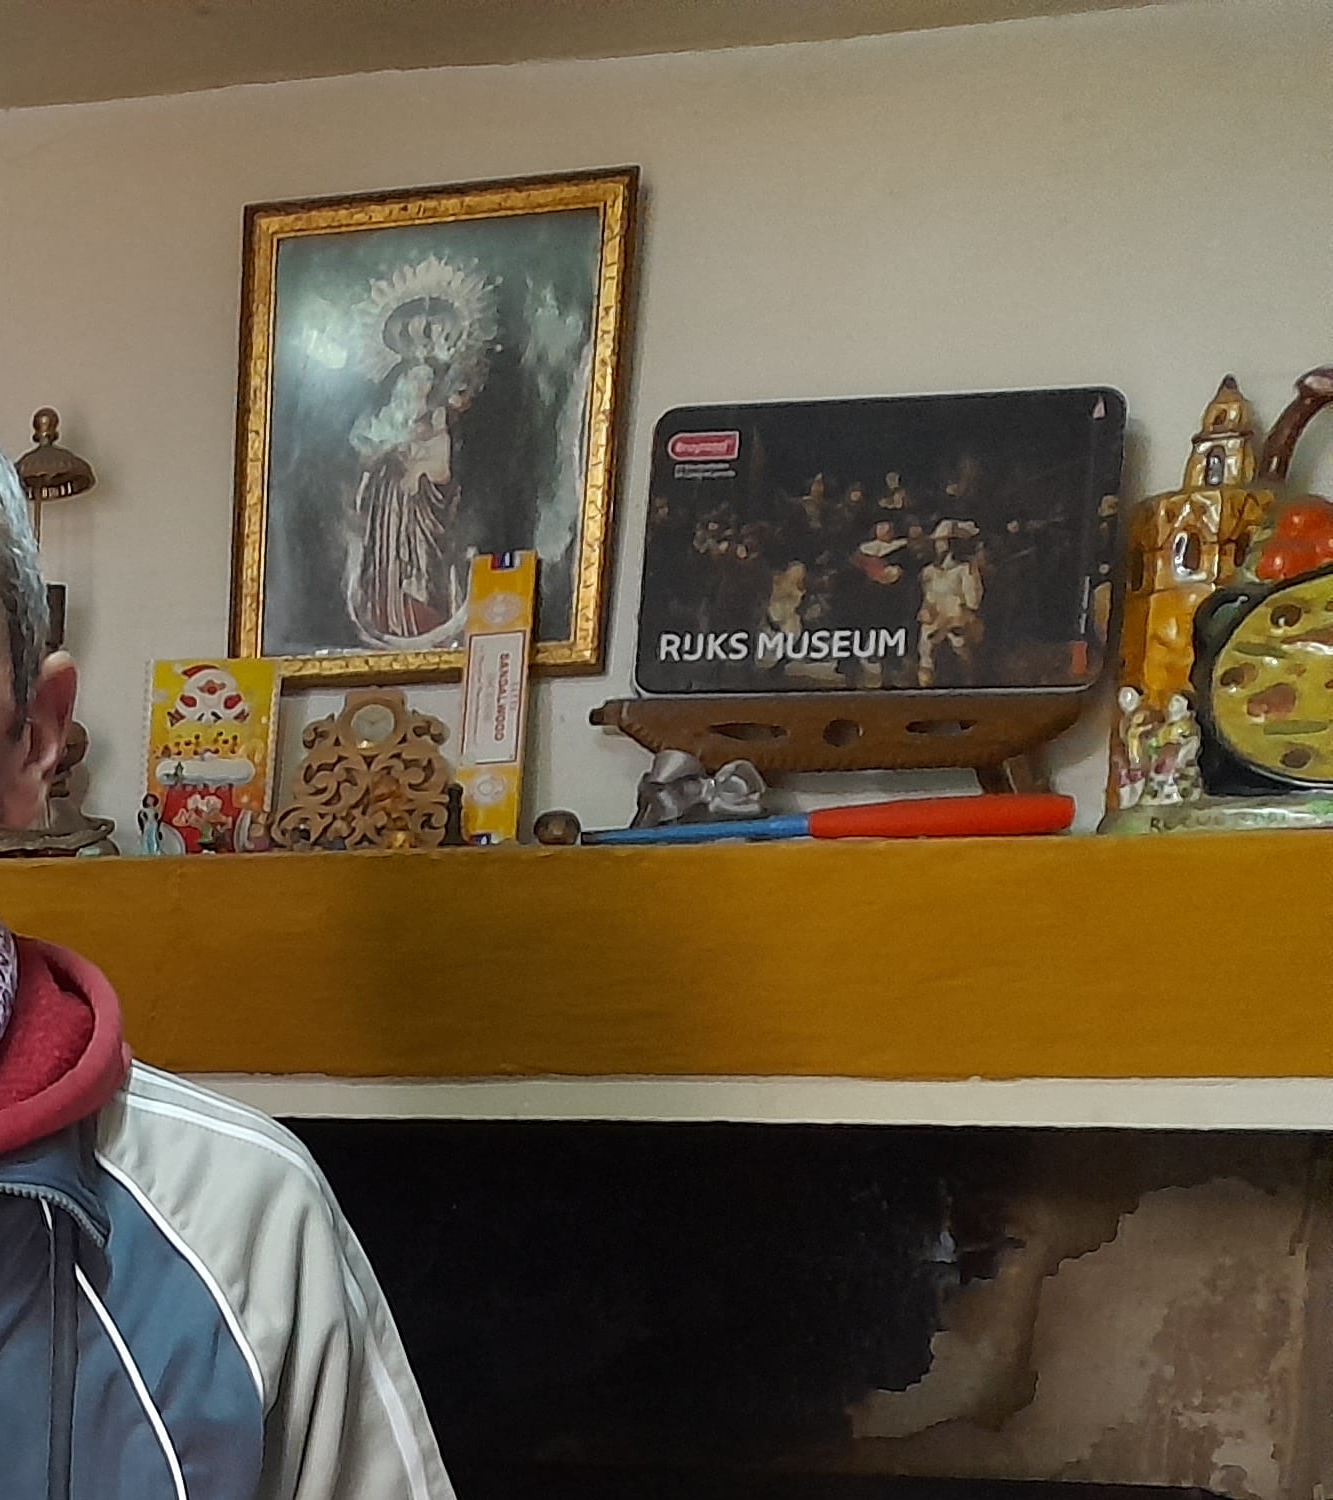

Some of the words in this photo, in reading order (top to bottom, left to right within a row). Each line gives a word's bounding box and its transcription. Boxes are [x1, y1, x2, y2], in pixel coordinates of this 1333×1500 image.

[659, 629, 749, 663] RIJKS
[756, 625, 908, 661] MUSEUM
[494, 651, 511, 743] SANDALWOOD
